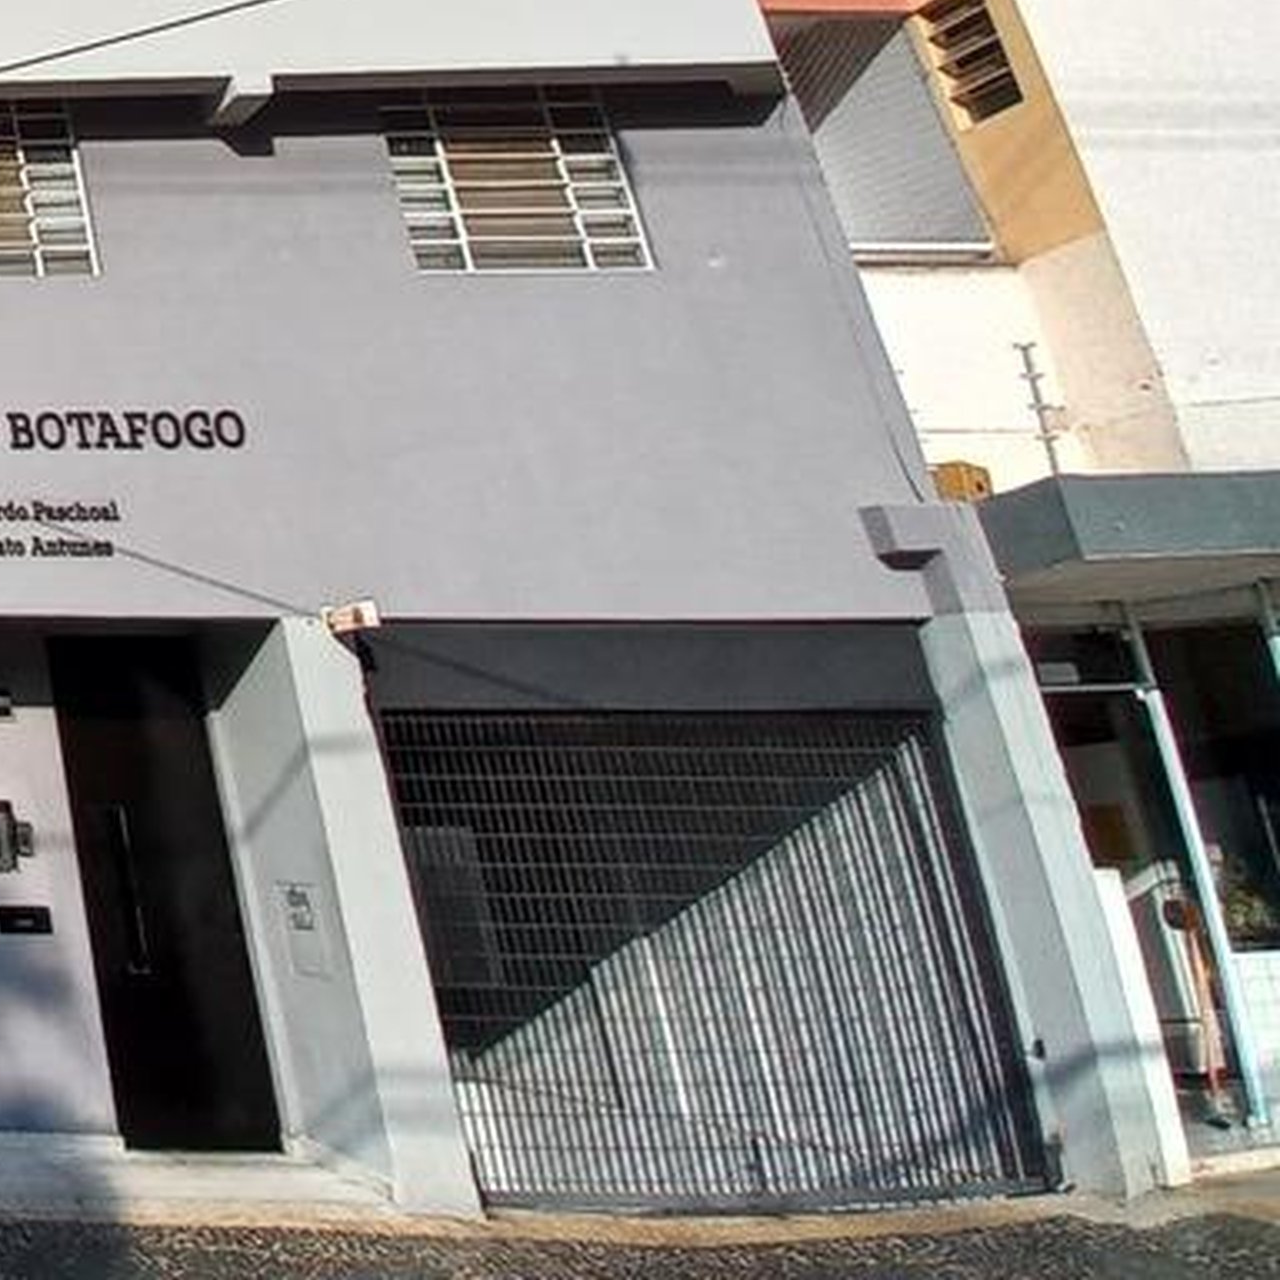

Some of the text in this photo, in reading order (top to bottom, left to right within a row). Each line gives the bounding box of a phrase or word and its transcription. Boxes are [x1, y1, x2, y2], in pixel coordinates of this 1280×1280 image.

[6, 410, 245, 450] BOTAFOGO
[31, 501, 120, 521] Paschoal
[31, 536, 114, 557] Antunes
